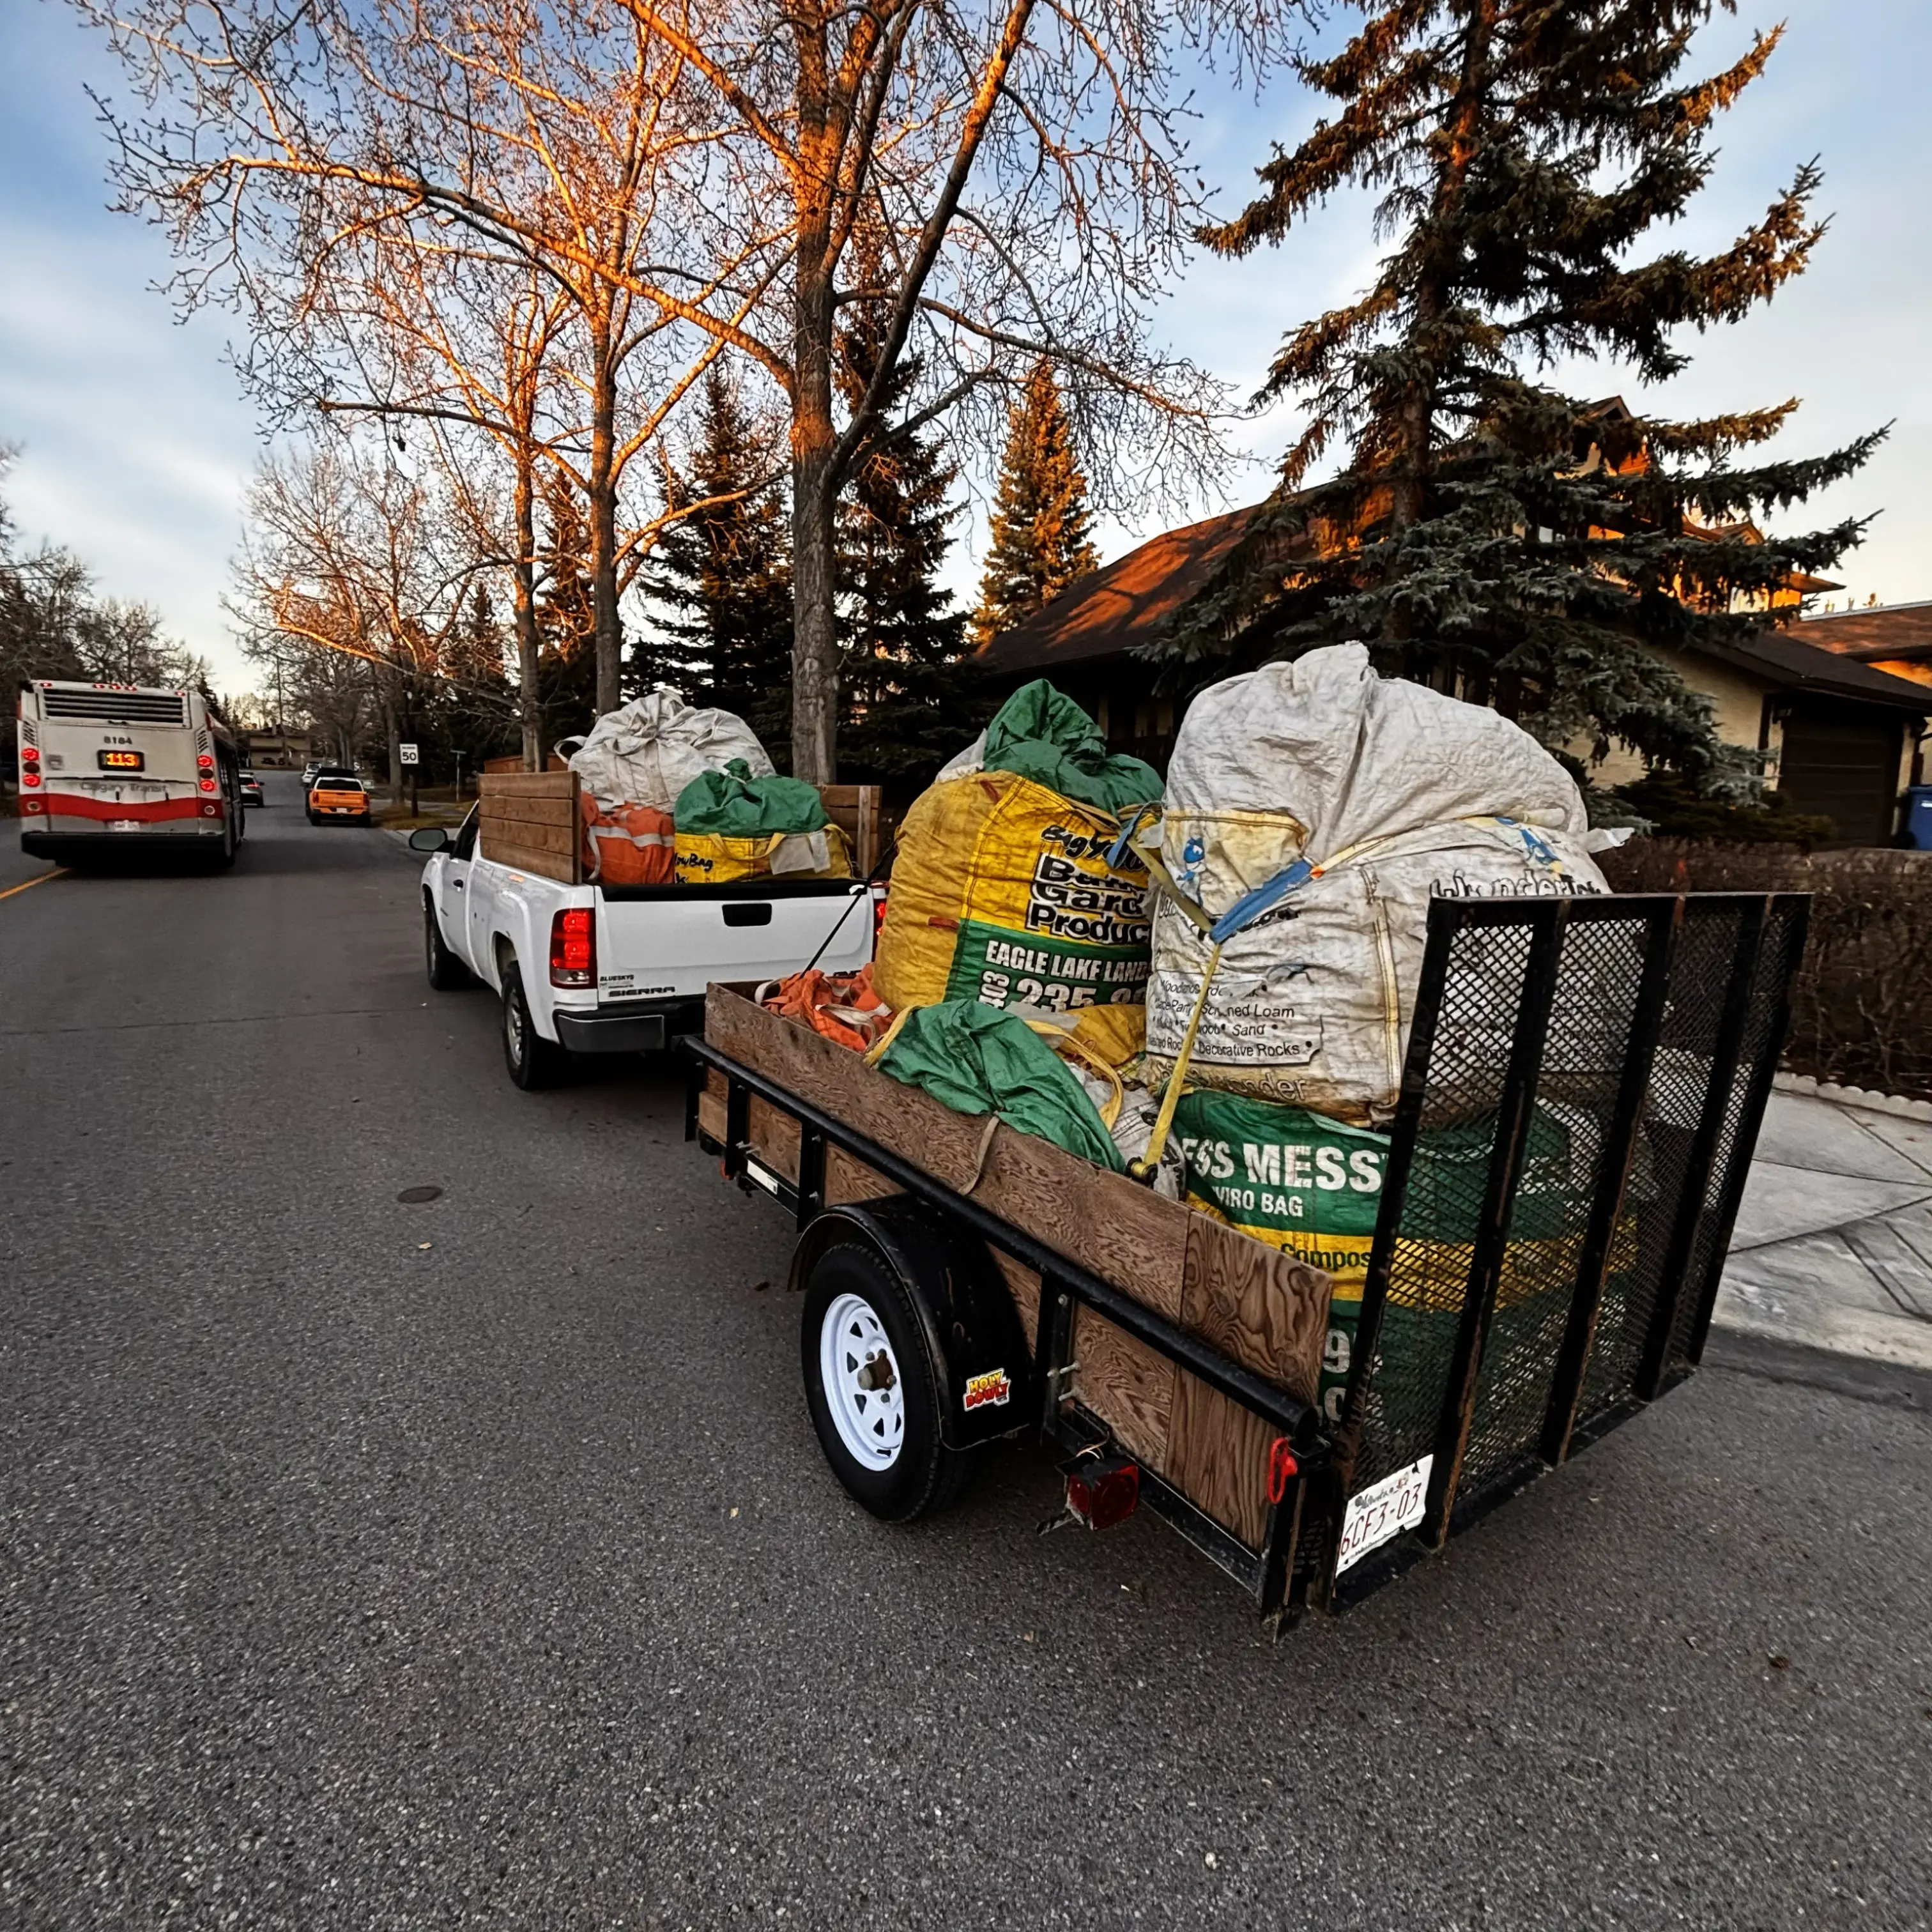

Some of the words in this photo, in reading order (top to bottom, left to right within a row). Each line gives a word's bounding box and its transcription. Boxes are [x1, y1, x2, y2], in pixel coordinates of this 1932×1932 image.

[106, 753, 137, 767] 113
[402, 751, 417, 761] 50
[986, 940, 1048, 975] EAGLE
[1050, 954, 1102, 981] LAKE
[608, 986, 676, 997] SIERRA
[1254, 1004, 1294, 1018] Loam
[1232, 1023, 1266, 1036] Sand
[1167, 1037, 1183, 1051] Roc
[1199, 1041, 1254, 1056] Decorative
[1256, 1041, 1300, 1057] Rocks
[1243, 1143, 1382, 1193] MESS
[1213, 1186, 1254, 1211] VIRO
[1261, 1193, 1303, 1217] BAG
[969, 1371, 1001, 1392] HOLY
